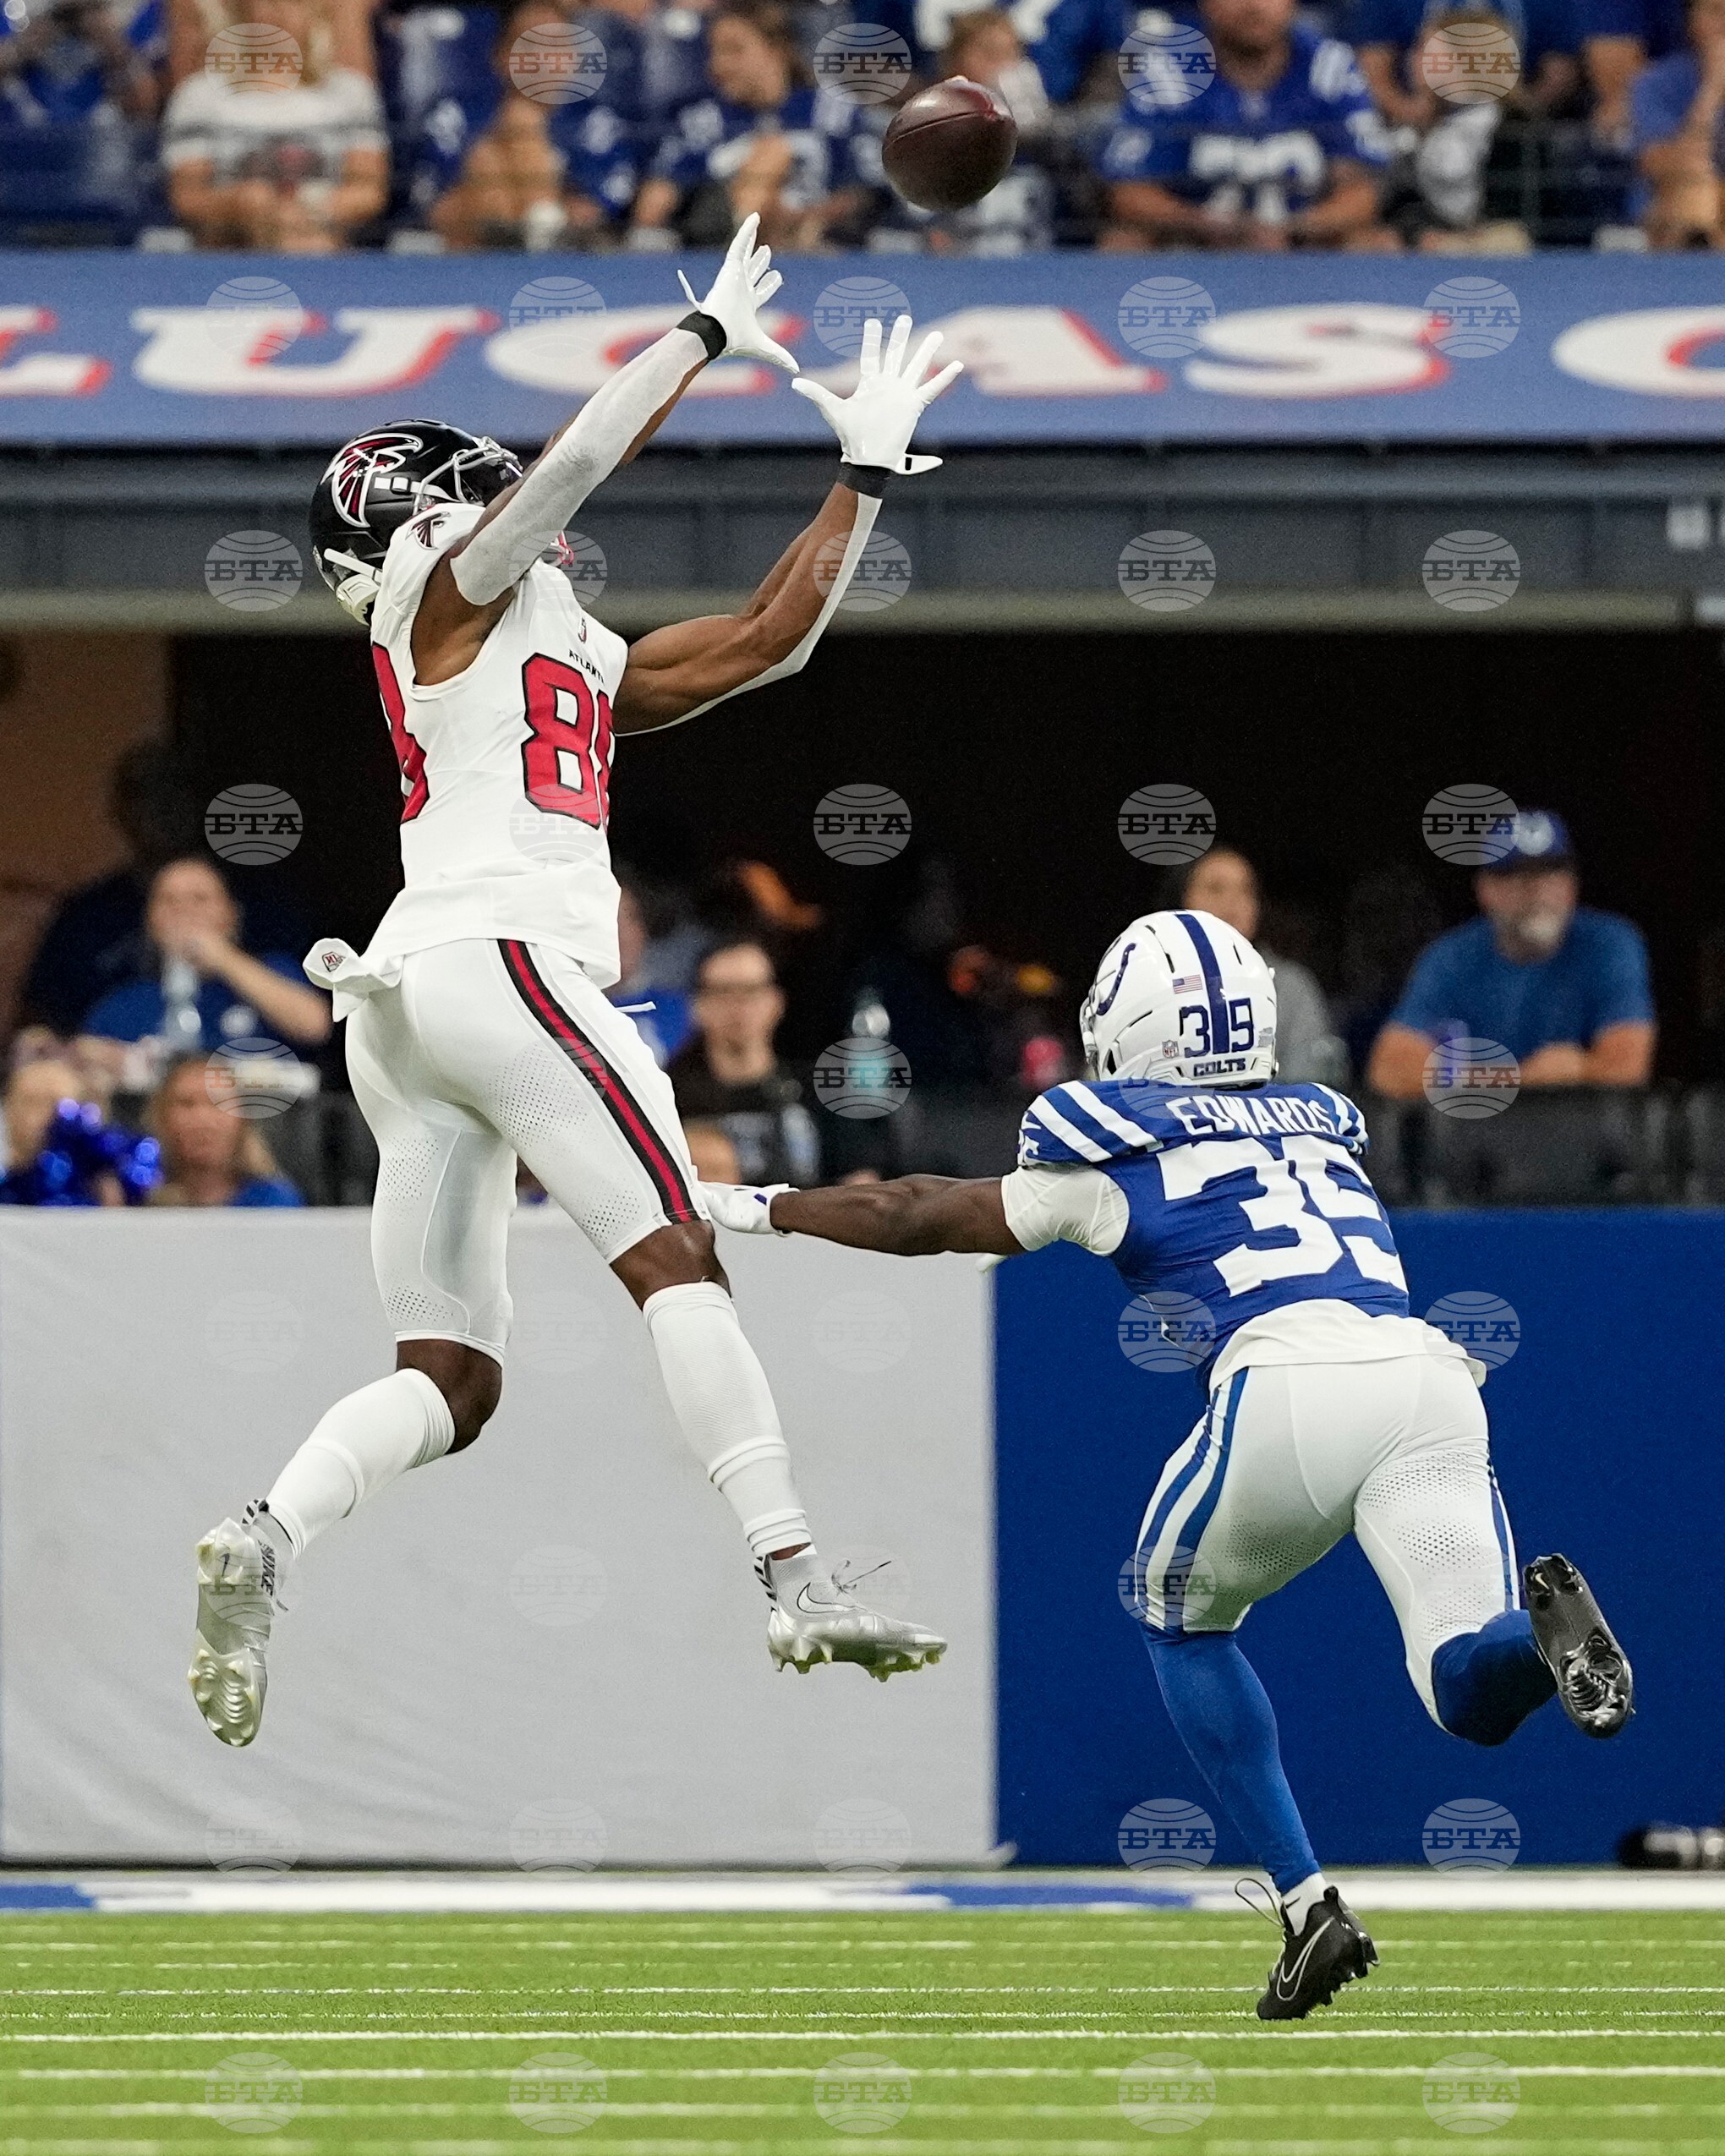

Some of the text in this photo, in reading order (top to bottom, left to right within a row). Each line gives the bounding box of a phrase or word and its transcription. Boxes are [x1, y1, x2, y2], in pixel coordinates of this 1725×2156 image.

[1193, 1058, 1246, 1077] COLTS
[1165, 1095, 1336, 1135] EDWARDS
[1156, 1134, 1410, 1297] 35
